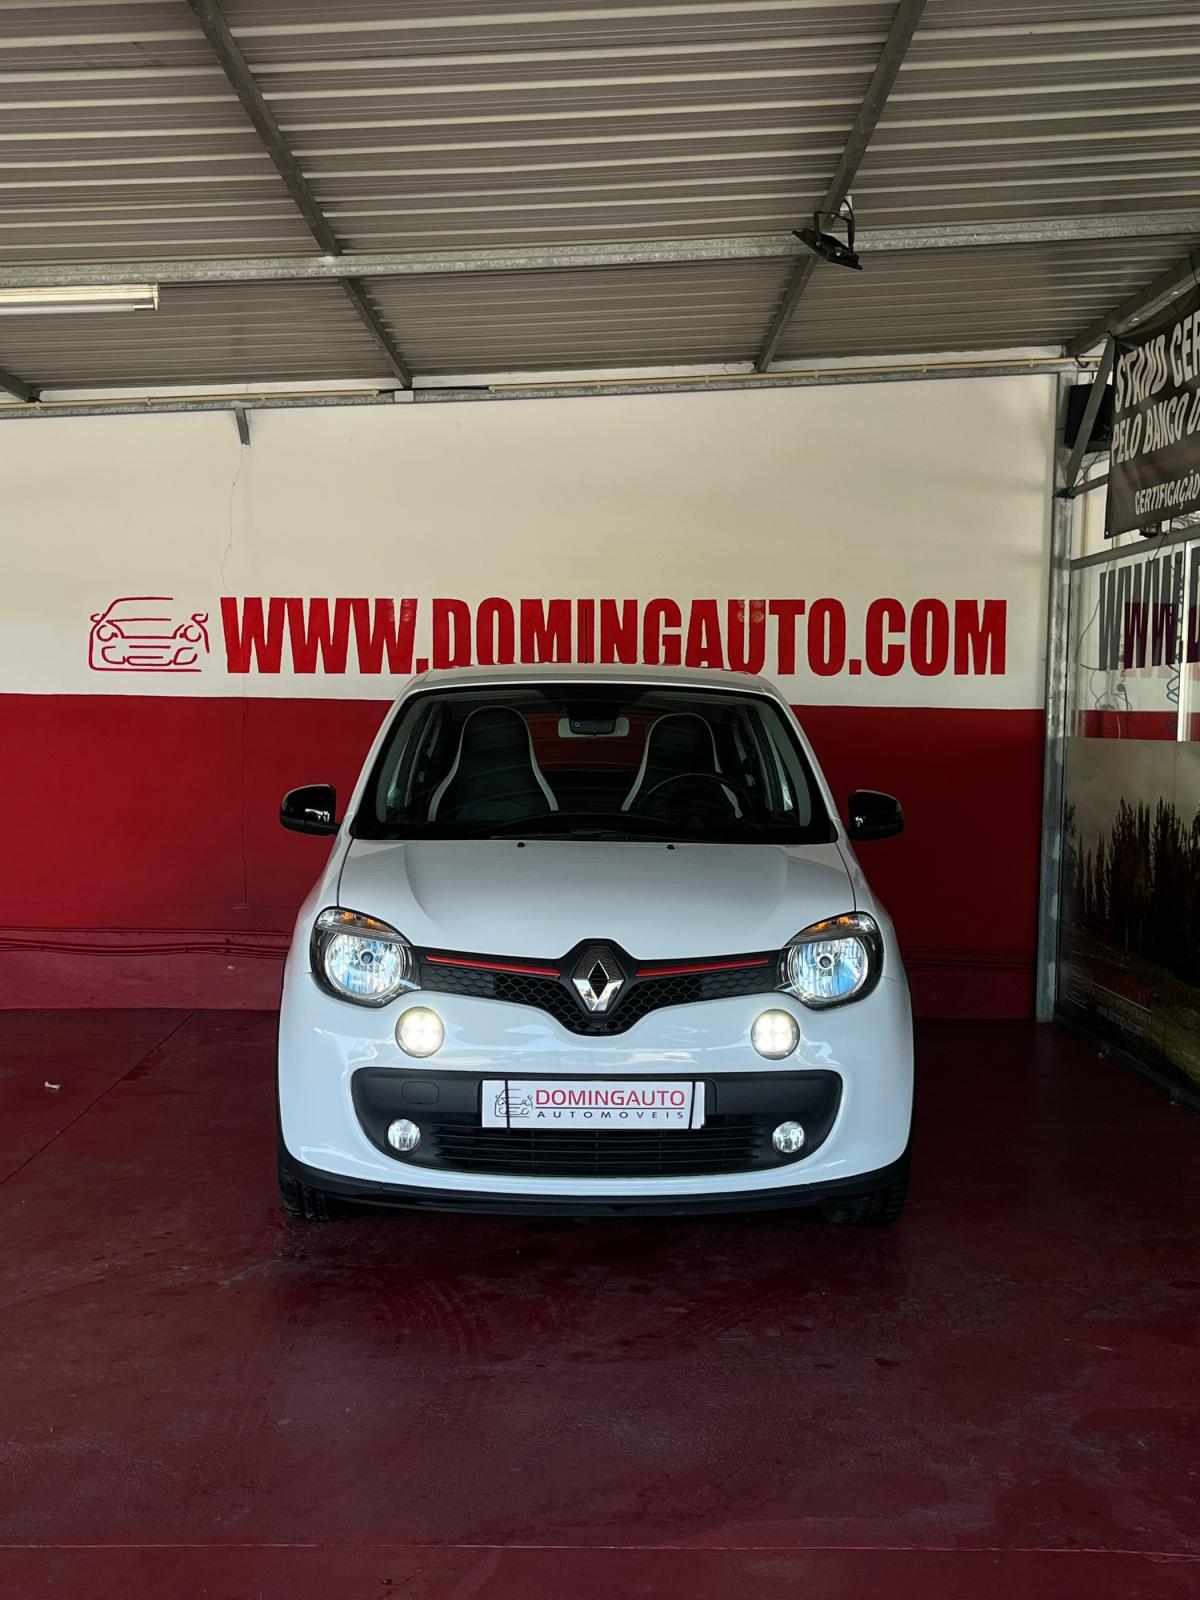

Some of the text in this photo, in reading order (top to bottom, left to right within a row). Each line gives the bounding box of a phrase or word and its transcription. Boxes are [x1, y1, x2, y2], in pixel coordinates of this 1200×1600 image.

[1115, 334, 1168, 414] STAND
[1111, 413, 1143, 467] PELO
[1142, 392, 1190, 454] BANCO
[220, 597, 1007, 676] WWW.DOMINGAUTO.COM
[536, 1089, 686, 1106] DOMINGAUTO
